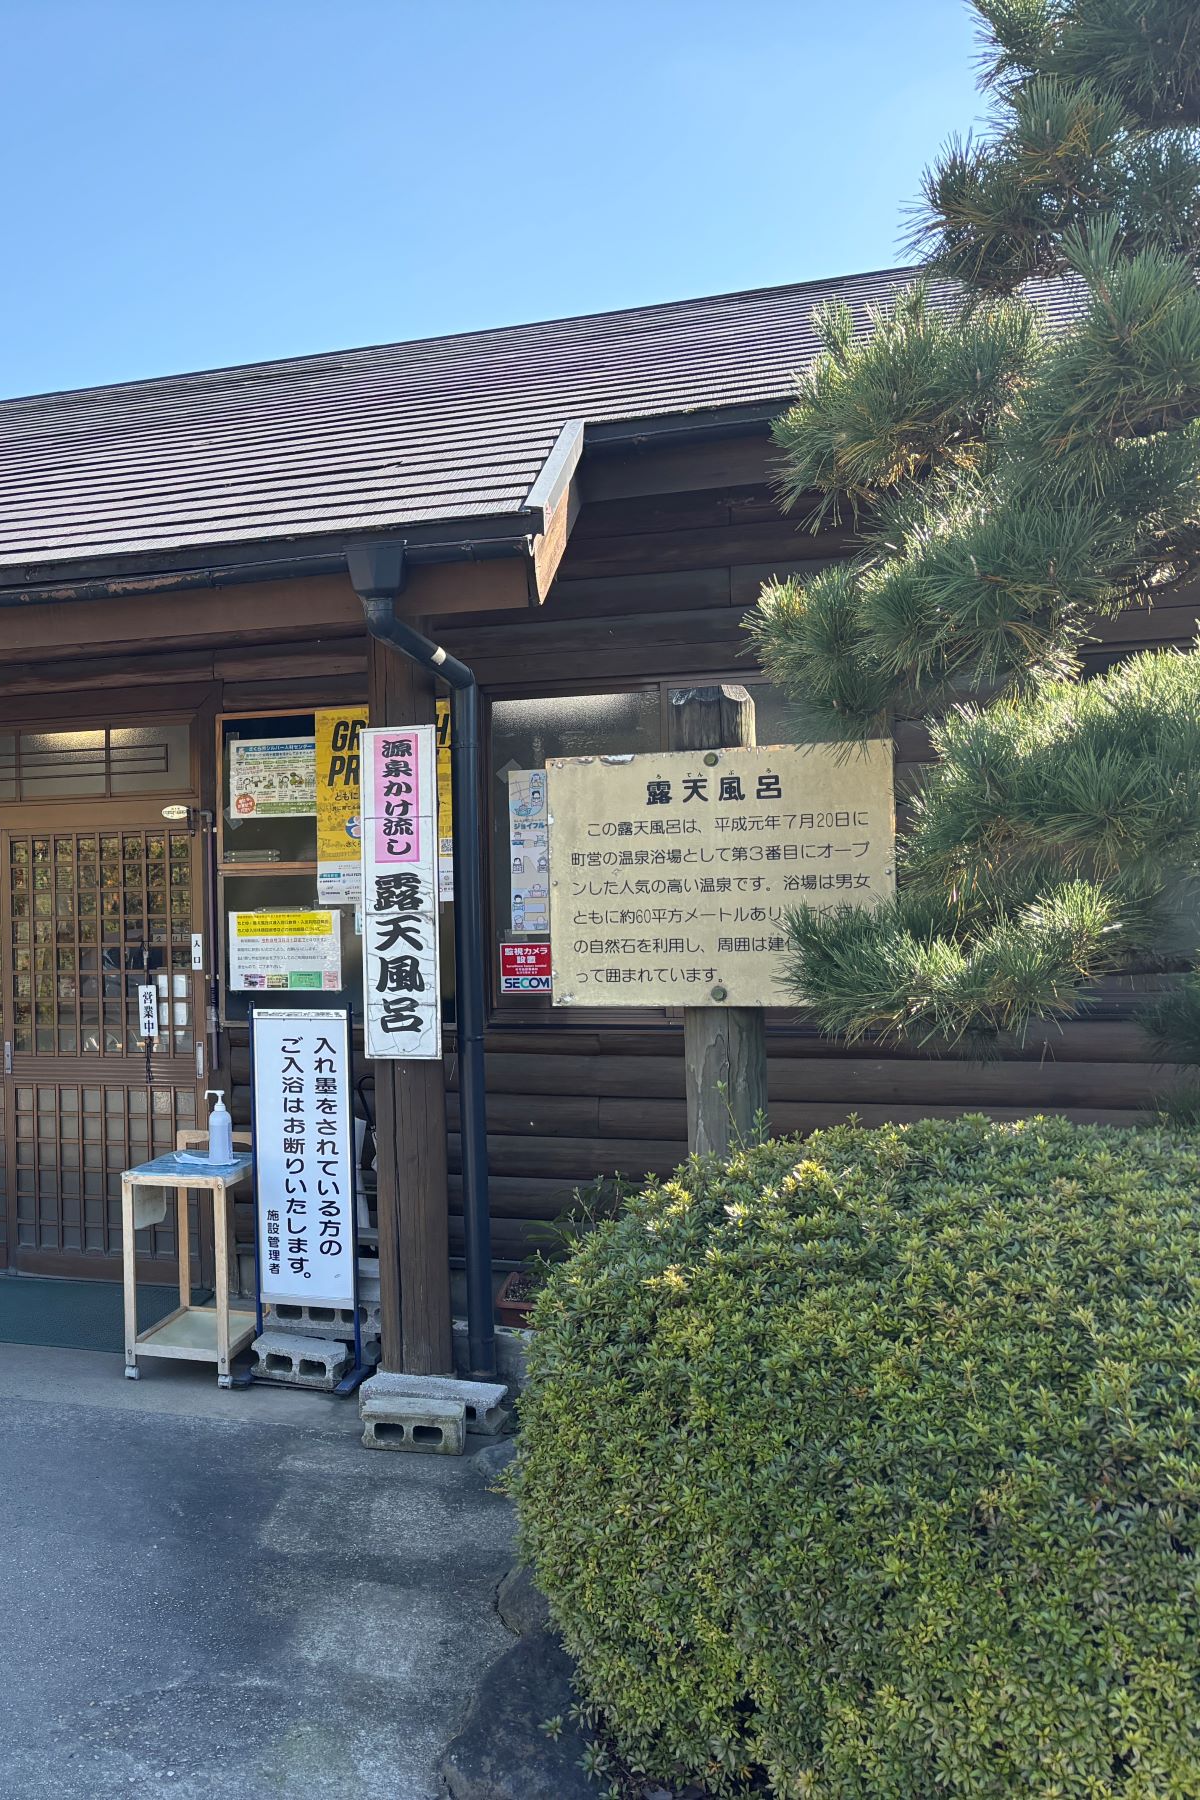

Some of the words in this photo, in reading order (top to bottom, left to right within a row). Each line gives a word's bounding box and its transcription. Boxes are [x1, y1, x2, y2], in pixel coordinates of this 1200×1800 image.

[382, 739, 414, 856] 源泉かけ流し
[646, 775, 782, 805] 露天風呂
[193, 940, 201, 964] 入口
[374, 872, 425, 1033] 露天風呂
[504, 948, 548, 956] 監視カメラ
[516, 956, 536, 964] 設置
[504, 977, 550, 988] SECOM
[576, 967, 723, 983] って囲まれています。
[142, 991, 154, 1034] 営業中
[281, 1037, 311, 1279] ご入浴はお断りいたします。
[313, 1037, 342, 1257] 入れ墨をされている方の
[266, 1209, 281, 1275] 施設管理者
